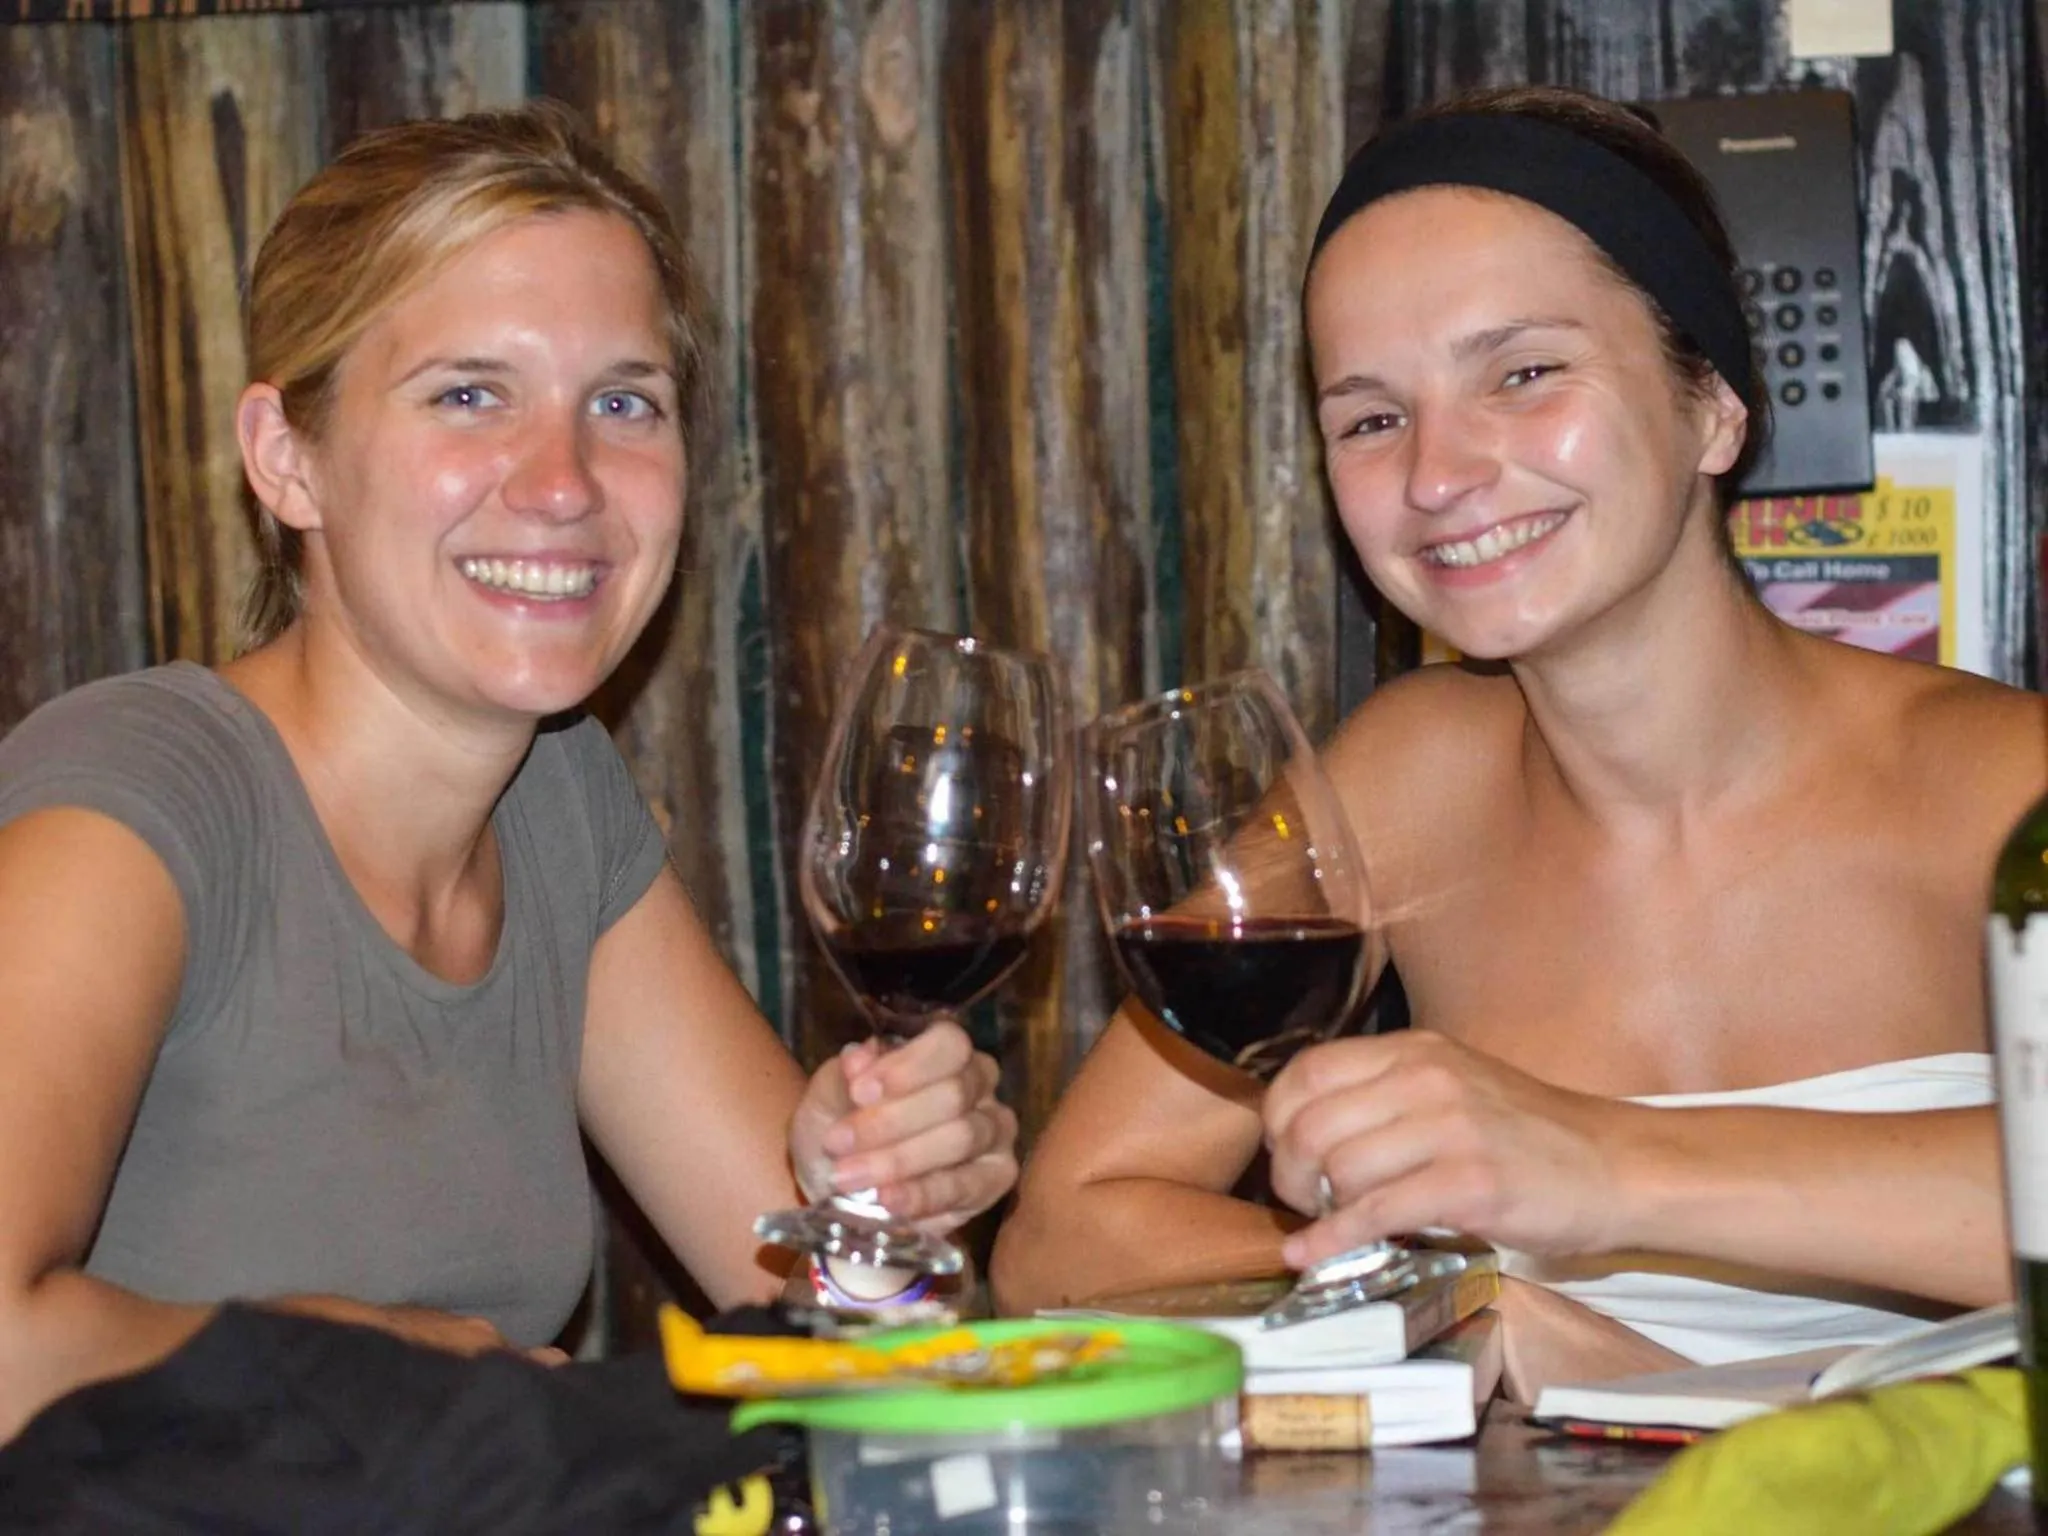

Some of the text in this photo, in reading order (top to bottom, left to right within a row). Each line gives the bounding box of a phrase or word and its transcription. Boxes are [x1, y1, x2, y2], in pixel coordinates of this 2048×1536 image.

[1900, 495, 1932, 521] 10
[1773, 560, 1819, 580] Call
[1822, 561, 1891, 580] Home
